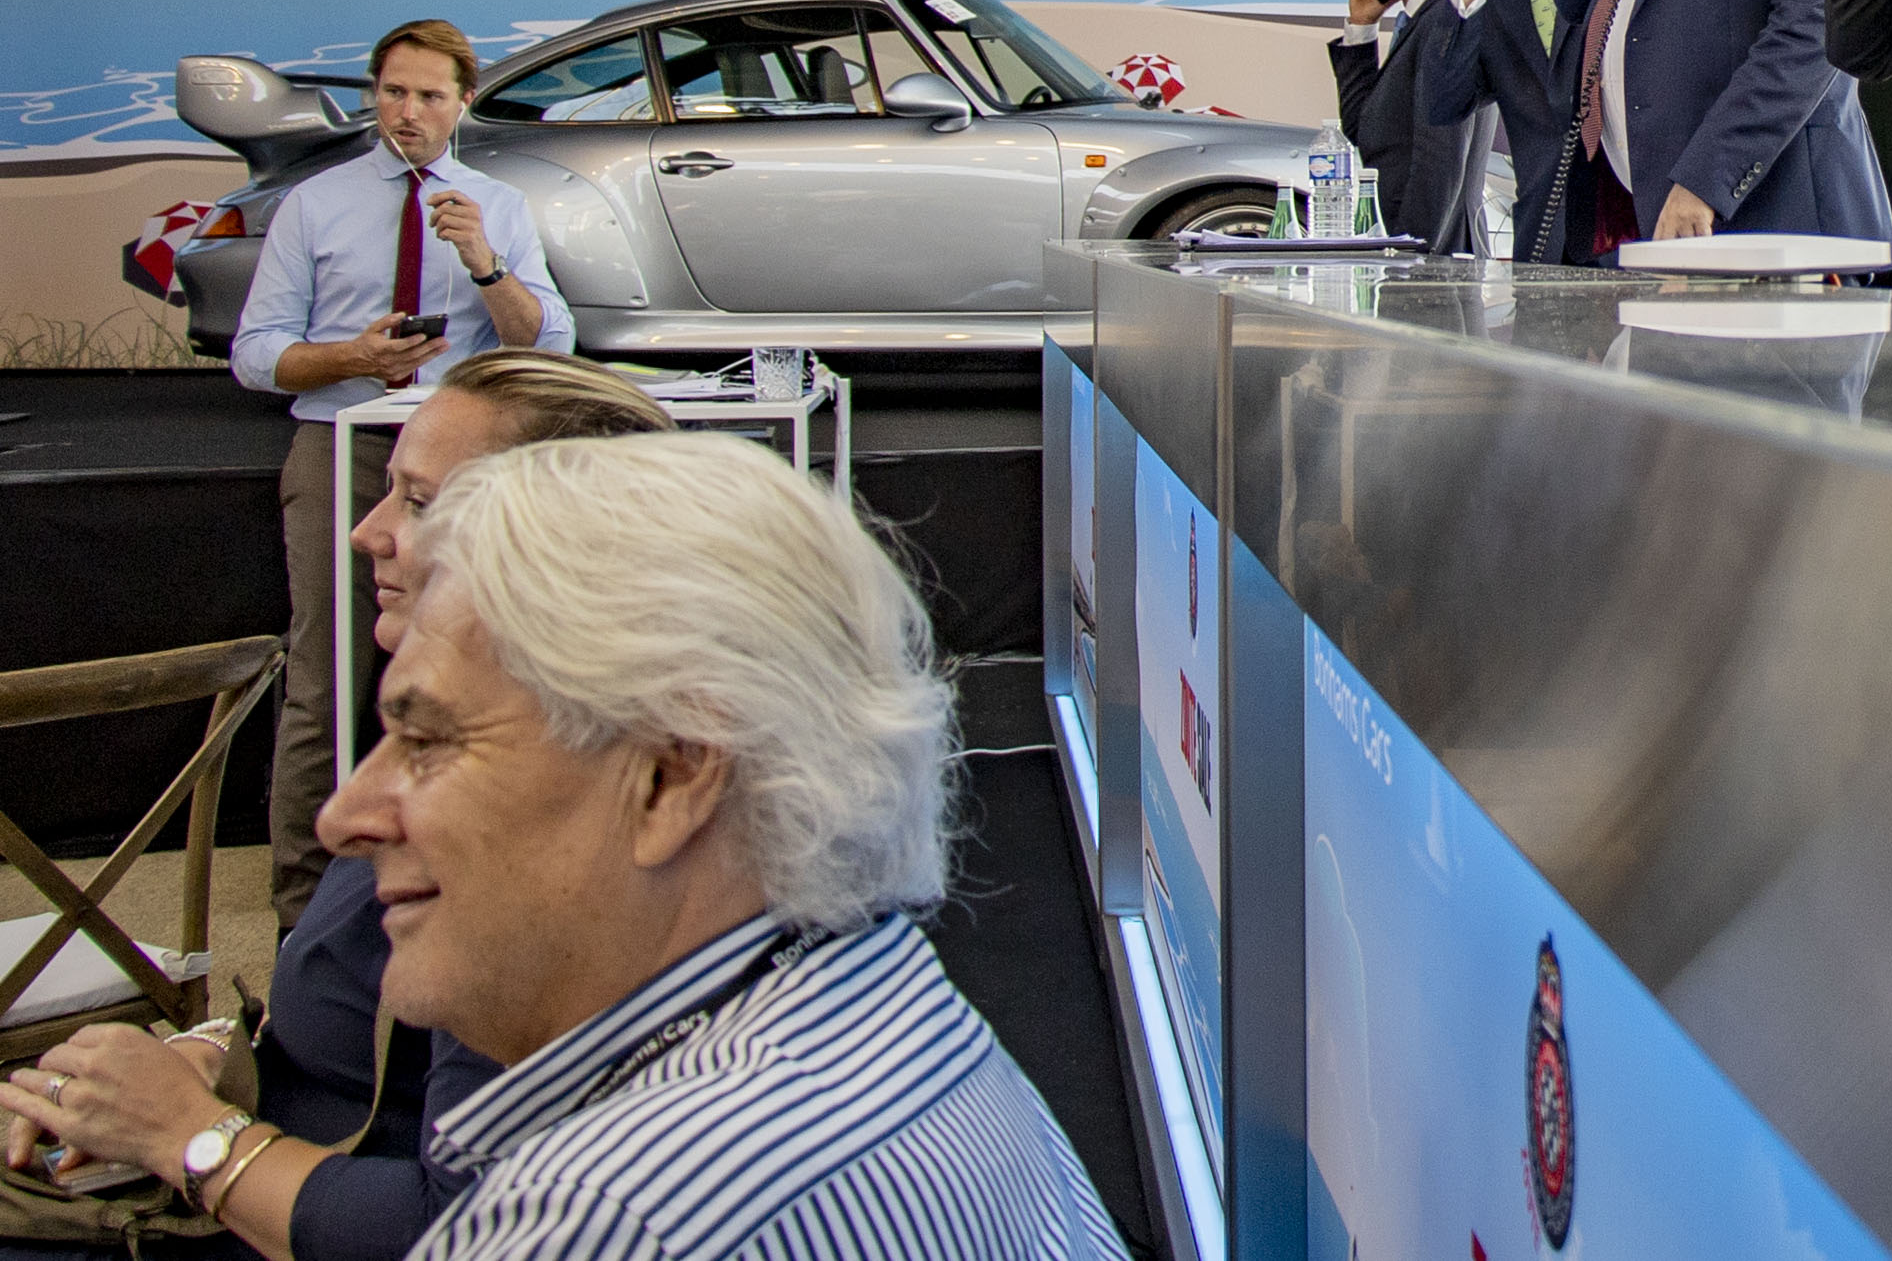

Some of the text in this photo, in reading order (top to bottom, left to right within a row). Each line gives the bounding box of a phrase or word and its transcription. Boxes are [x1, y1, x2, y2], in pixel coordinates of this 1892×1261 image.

[1361, 696, 1392, 786] Cars
[772, 926, 827, 968] Bonha
[662, 1009, 710, 1042] Cars
